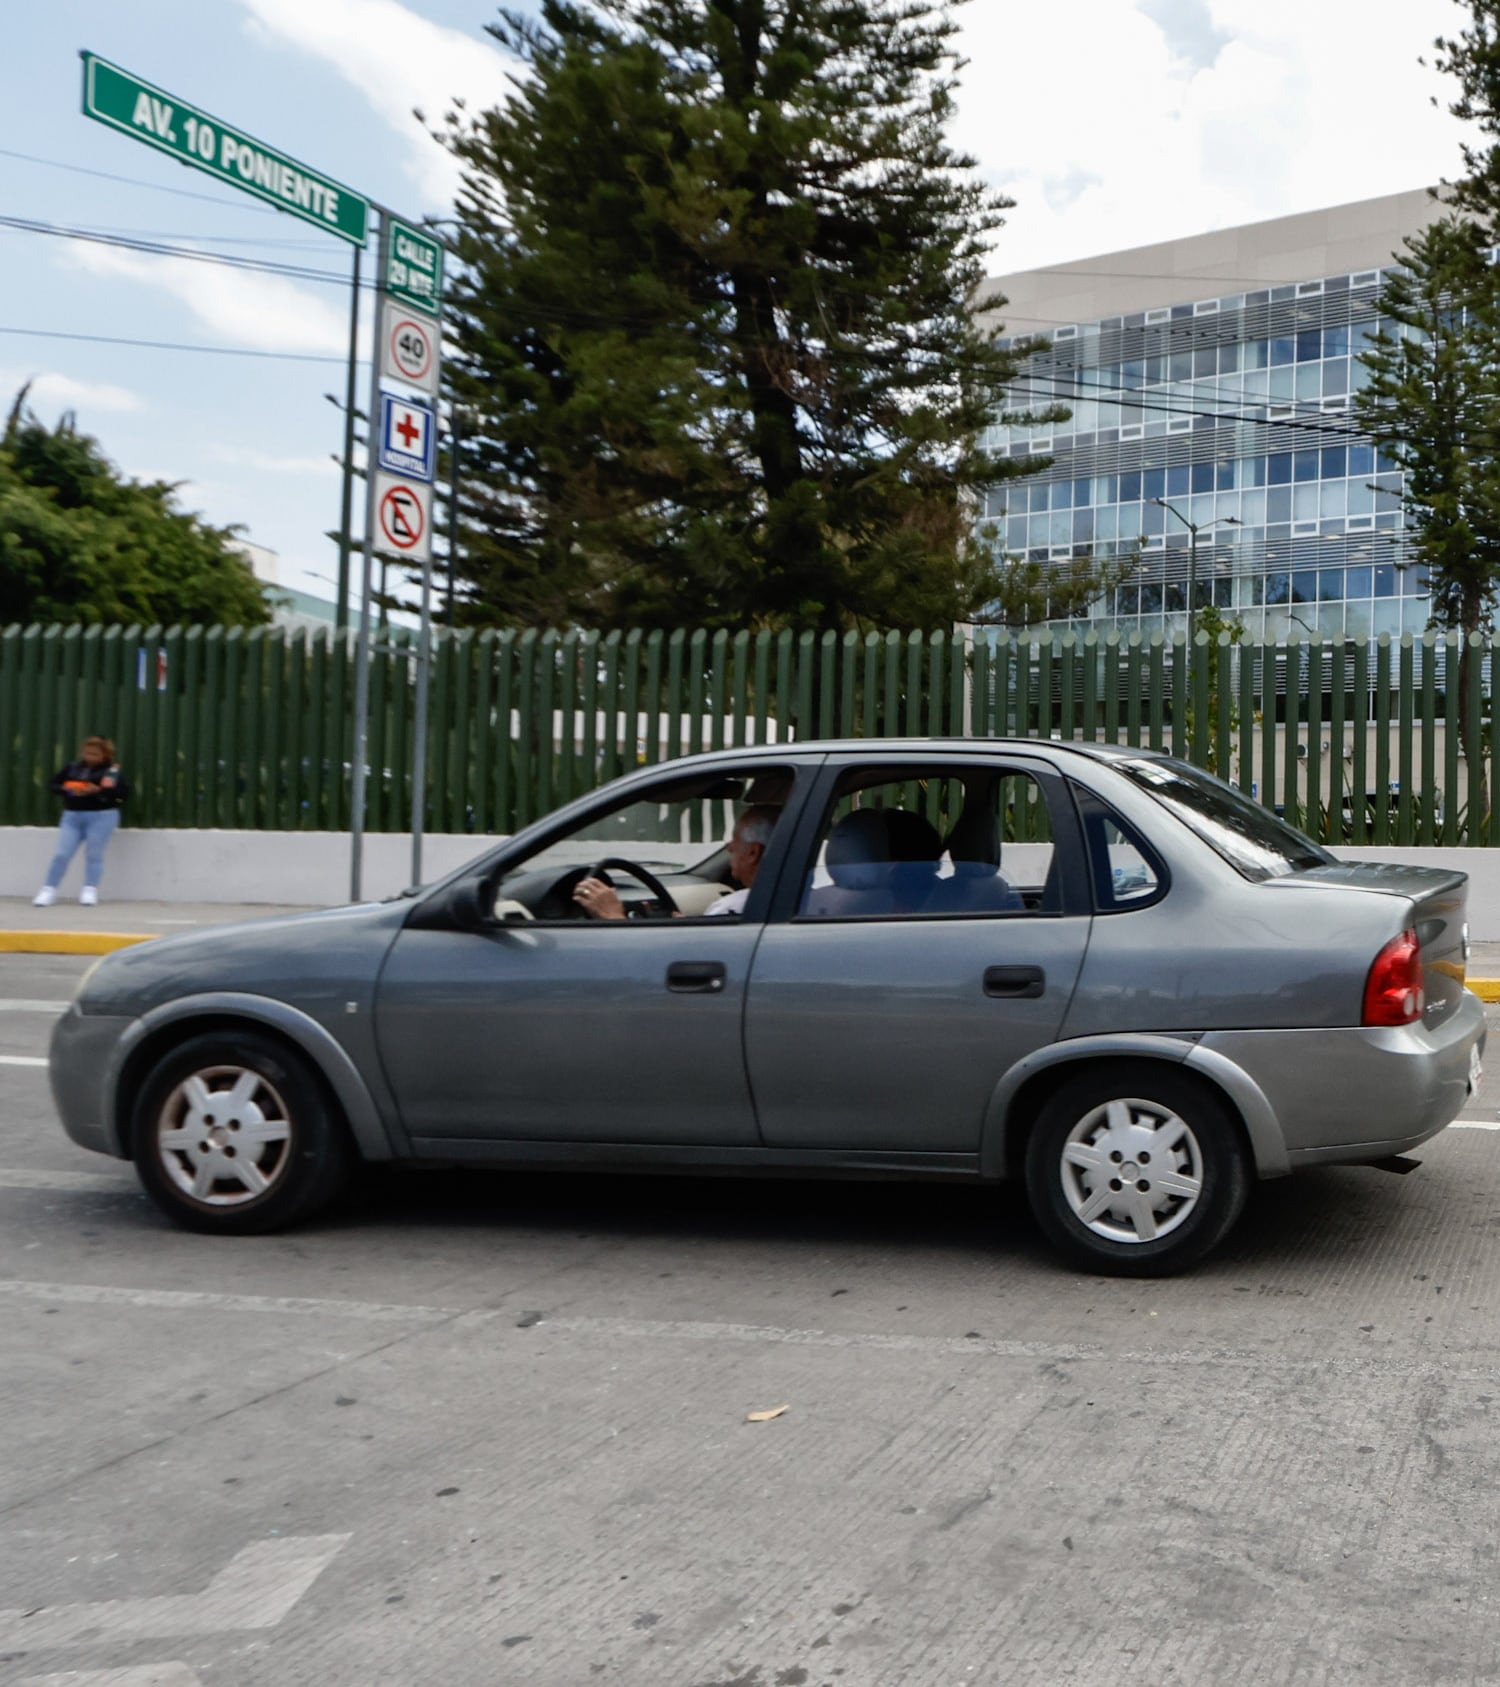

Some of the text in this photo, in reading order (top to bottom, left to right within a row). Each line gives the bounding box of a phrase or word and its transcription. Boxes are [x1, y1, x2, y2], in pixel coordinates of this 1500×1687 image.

[132, 92, 340, 223] AV. 10 PONIENTE
[396, 234, 435, 273] CALLE
[399, 333, 425, 359] 40
